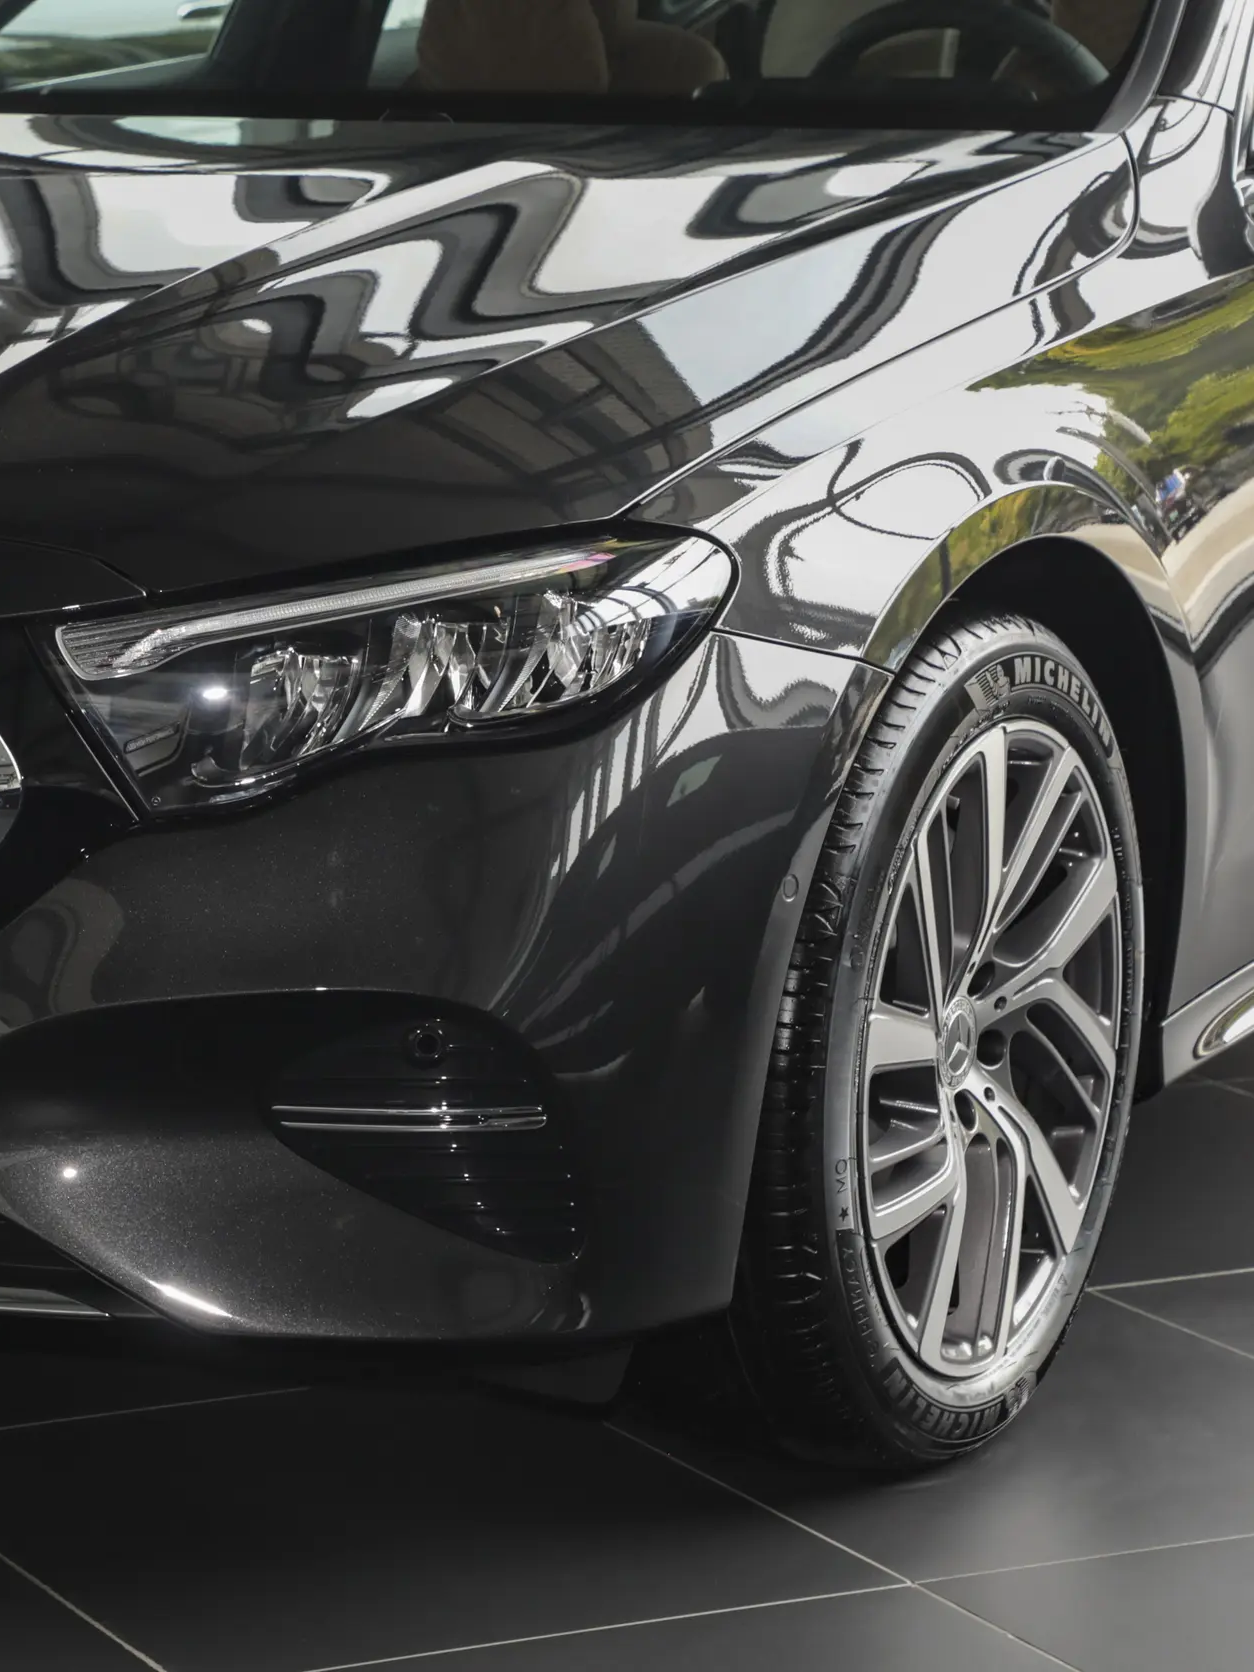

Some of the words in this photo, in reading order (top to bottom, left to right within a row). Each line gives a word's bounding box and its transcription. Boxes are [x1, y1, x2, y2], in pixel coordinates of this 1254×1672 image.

[1013, 655, 1113, 748] MICHELIN
[835, 1158, 848, 1194] MO
[882, 1366, 1003, 1440] MICHELIN
